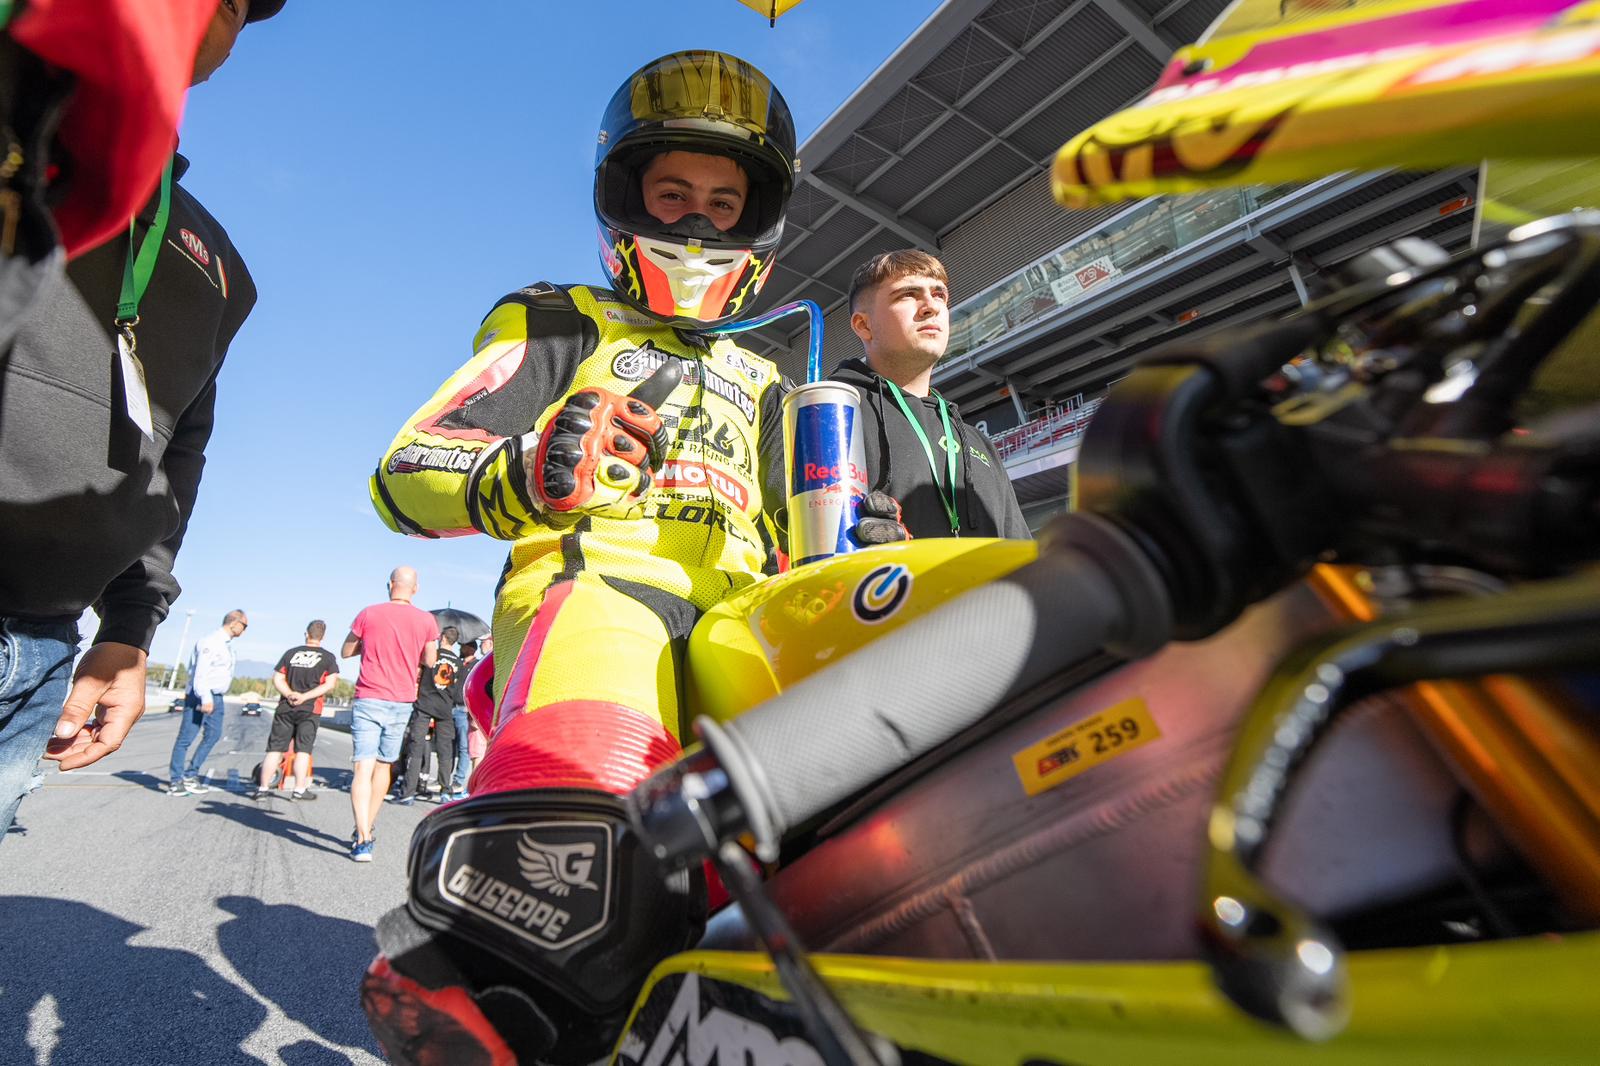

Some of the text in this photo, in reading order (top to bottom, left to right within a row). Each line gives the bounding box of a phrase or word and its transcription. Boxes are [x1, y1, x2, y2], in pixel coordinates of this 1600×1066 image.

[181, 230, 209, 263] RMS
[655, 462, 745, 507] MOTUL
[1089, 716, 1140, 755] 259
